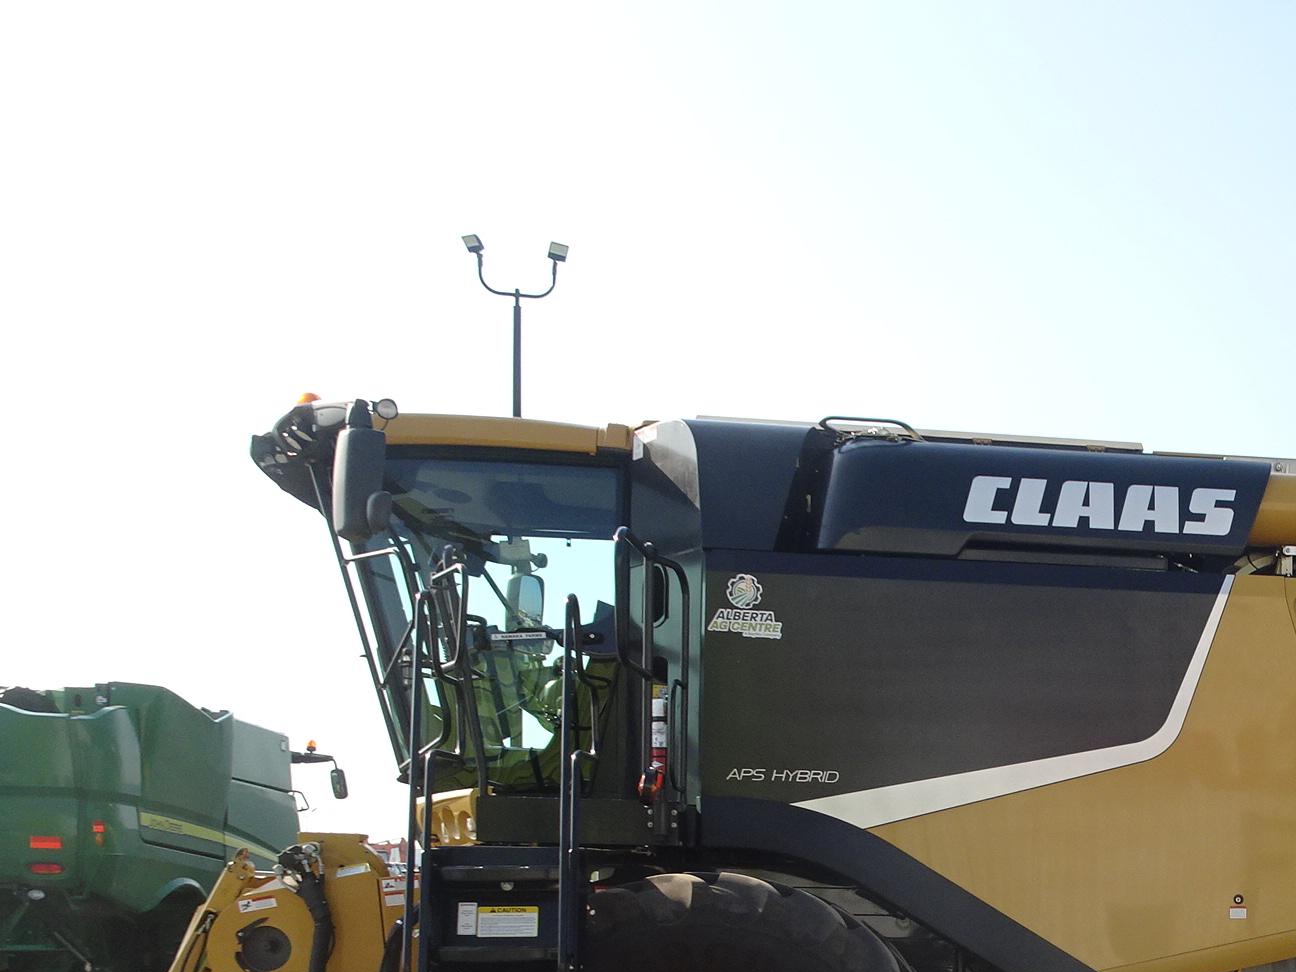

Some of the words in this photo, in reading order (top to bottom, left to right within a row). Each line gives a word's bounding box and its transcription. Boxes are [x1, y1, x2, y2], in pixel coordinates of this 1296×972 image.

[963, 475, 1237, 536] CLAAS
[716, 610, 774, 622] ALBERTA
[709, 620, 729, 630] AG
[731, 621, 781, 633] CENTRE
[726, 768, 766, 781] APS
[771, 769, 840, 783] HYBRID
[497, 903, 526, 912] CAUTION
